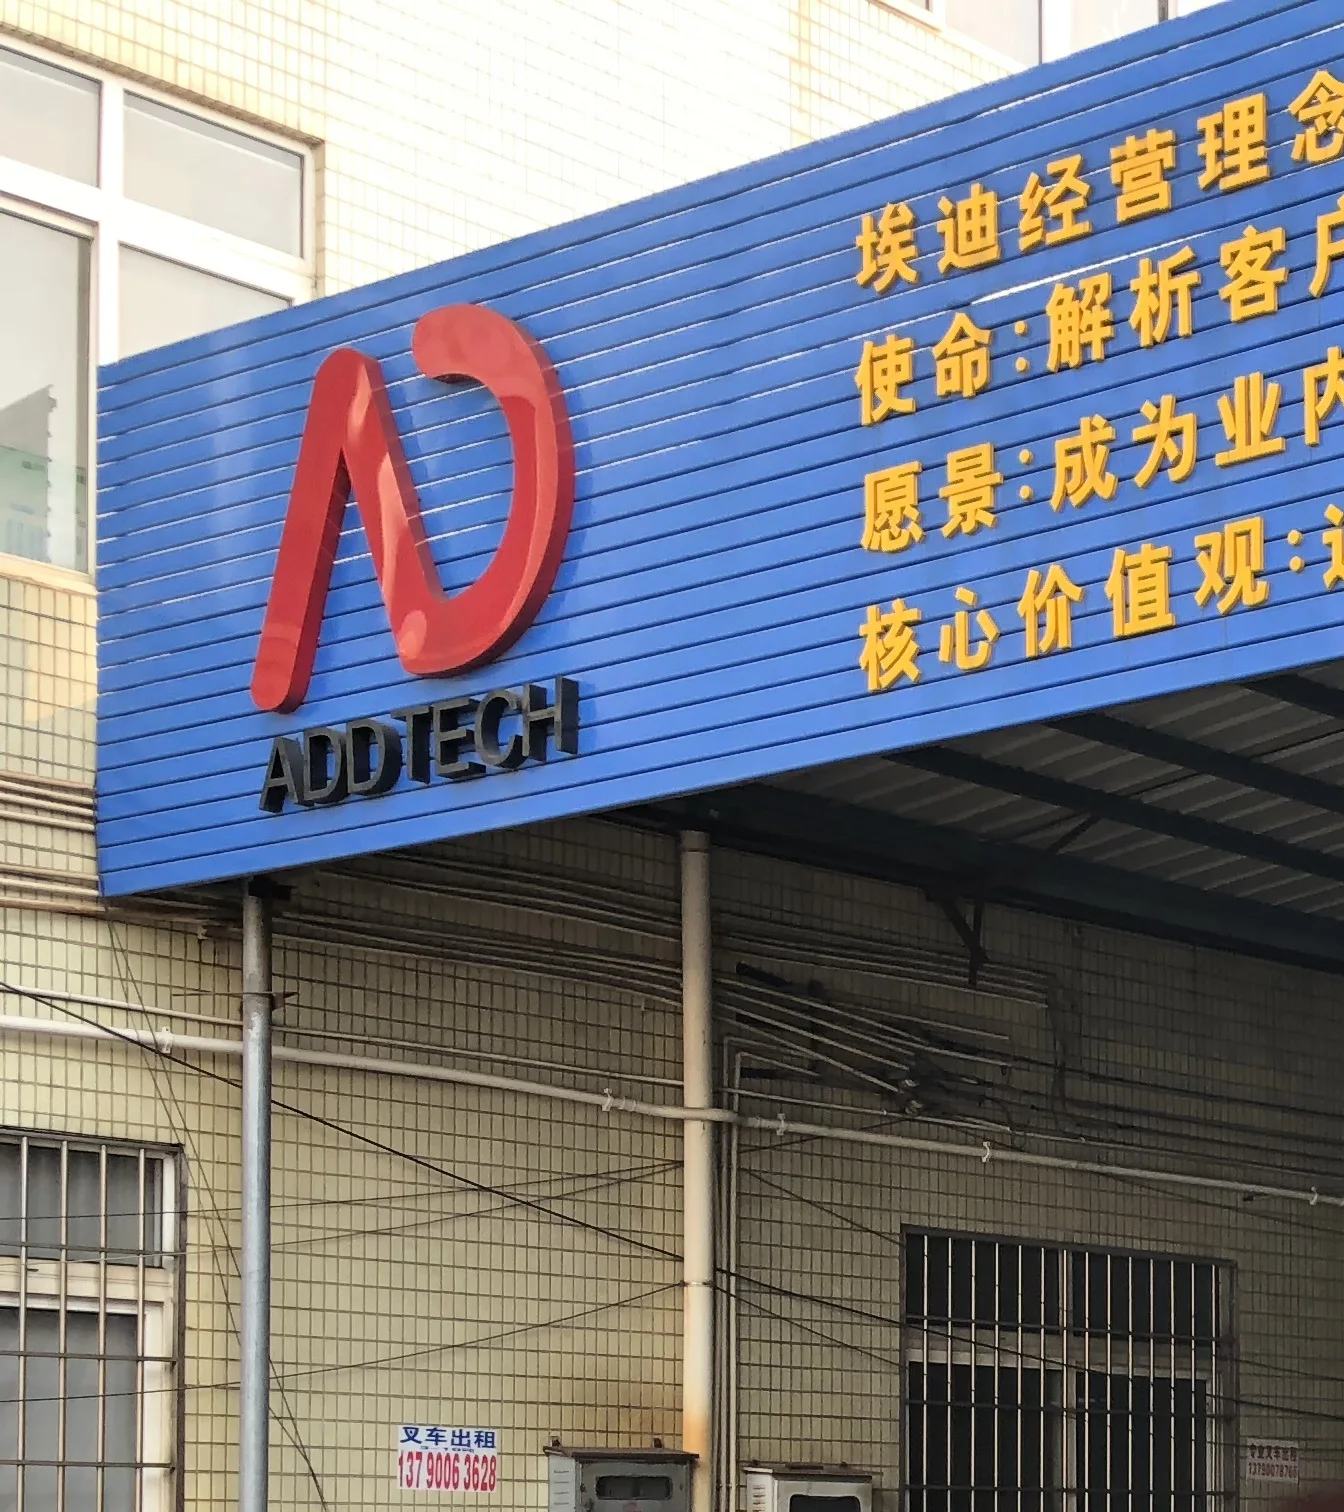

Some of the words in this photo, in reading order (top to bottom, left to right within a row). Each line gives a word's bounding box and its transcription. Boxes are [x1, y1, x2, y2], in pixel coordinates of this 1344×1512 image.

[258, 675, 580, 813] ADDTECH
[400, 1426, 496, 1449] 叉车出租
[398, 1450, 423, 1489] 137
[426, 1451, 460, 1490] 9006
[463, 1453, 497, 1492] 3628
